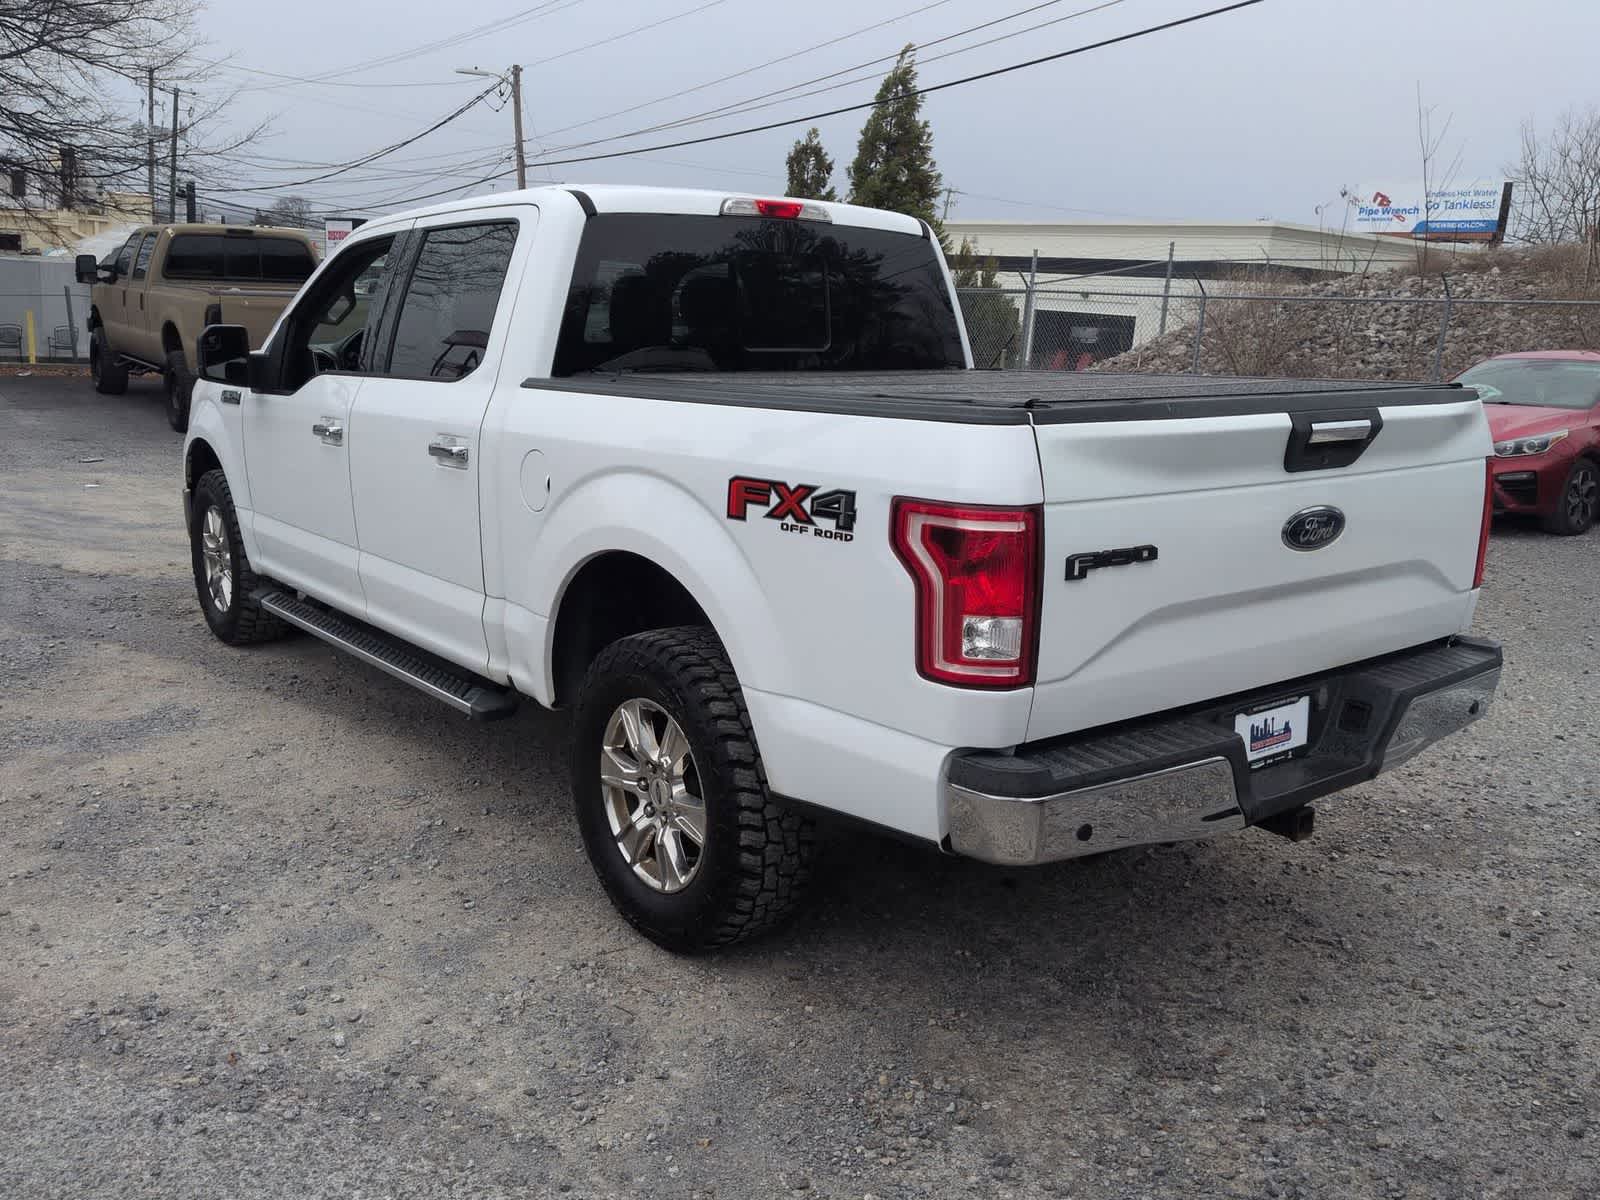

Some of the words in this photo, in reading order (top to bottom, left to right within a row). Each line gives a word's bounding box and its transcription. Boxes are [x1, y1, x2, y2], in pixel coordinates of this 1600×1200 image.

[1473, 189, 1497, 197] Water
[1426, 201, 1439, 210] Go
[1444, 200, 1496, 210] Tankless!
[1358, 207, 1379, 216] Pipe
[1382, 207, 1419, 215] Wrench
[727, 475, 857, 532] FX4
[780, 522, 808, 534] OFF
[814, 528, 854, 542] ROAD
